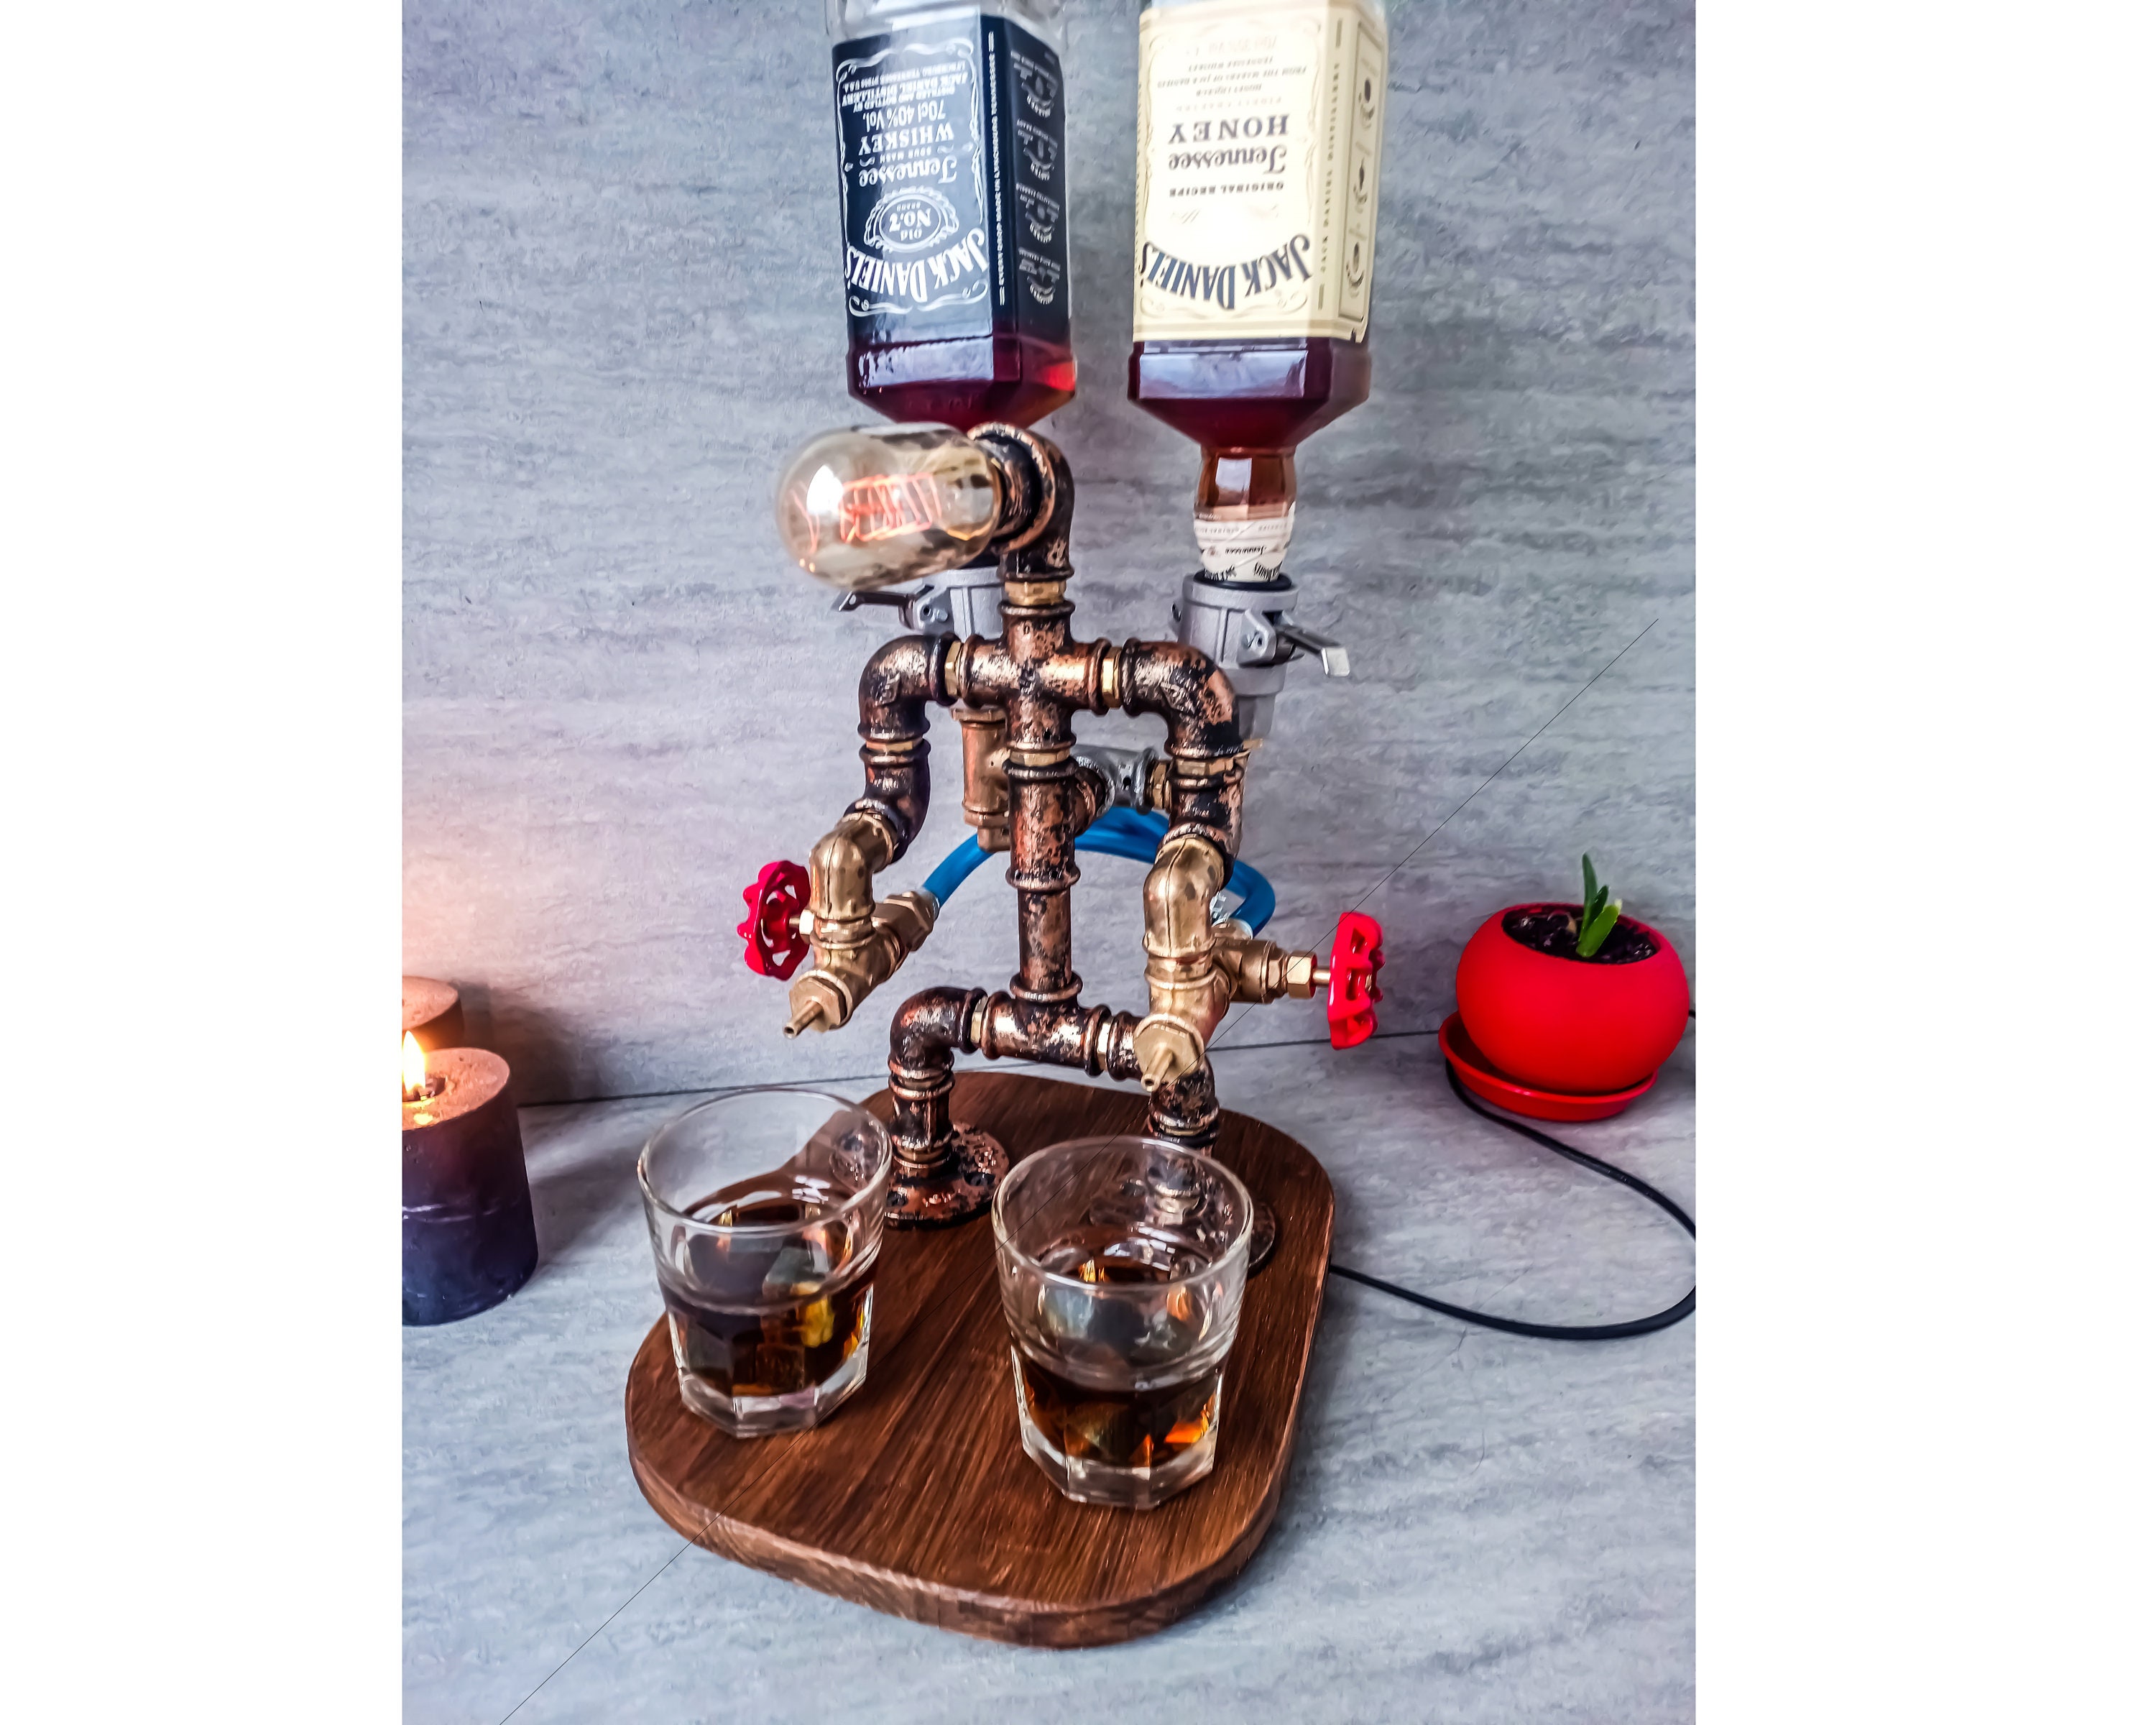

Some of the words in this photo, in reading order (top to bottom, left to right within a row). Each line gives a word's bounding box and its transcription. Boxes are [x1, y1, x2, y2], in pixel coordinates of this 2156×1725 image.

[842, 87, 897, 107] DISTILLERY
[898, 93, 914, 103] AND
[887, 104, 916, 129] 40%
[918, 99, 946, 123] 70cl
[858, 121, 954, 156] WHISKEY
[1167, 114, 1290, 145] HONEY
[880, 152, 904, 164] MASH
[908, 146, 931, 159] SOUR
[1168, 144, 1287, 175] Tennessee
[859, 155, 957, 187] Tennessee
[1169, 184, 1217, 198] RECIPE
[1220, 180, 1284, 194] ORIGINAL
[900, 229, 923, 242] Old
[928, 228, 990, 290] JACK
[1241, 234, 1313, 297] JACK
[844, 245, 927, 303] DANIEL'S
[1138, 242, 1235, 310] DANIEL'S
